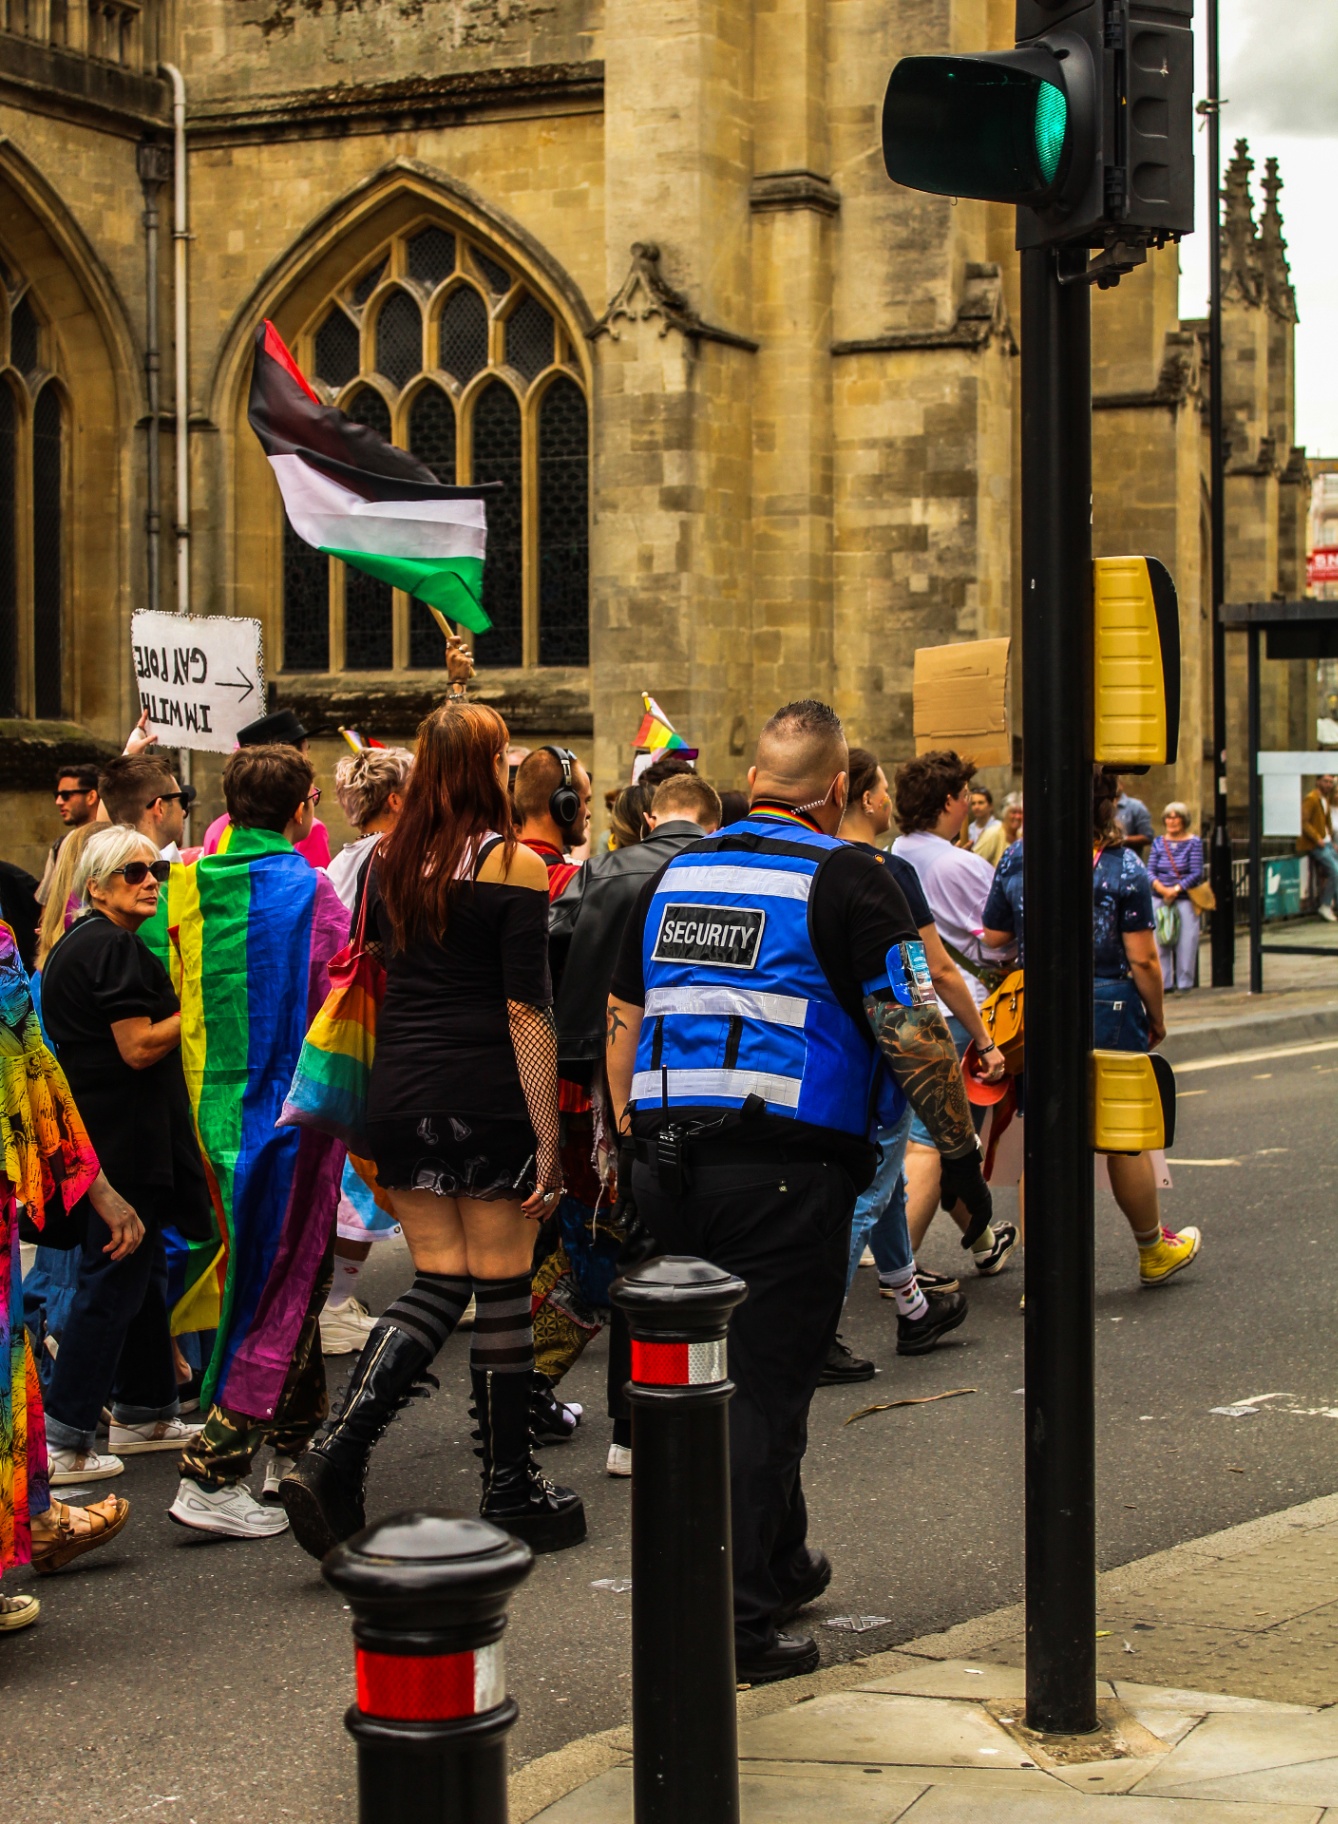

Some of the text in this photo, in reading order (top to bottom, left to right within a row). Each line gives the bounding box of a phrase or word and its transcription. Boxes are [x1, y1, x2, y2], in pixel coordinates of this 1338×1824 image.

[133, 646, 208, 686] GAY POPE
[141, 692, 213, 734] I'M WITH
[663, 920, 756, 950] SECURITY
